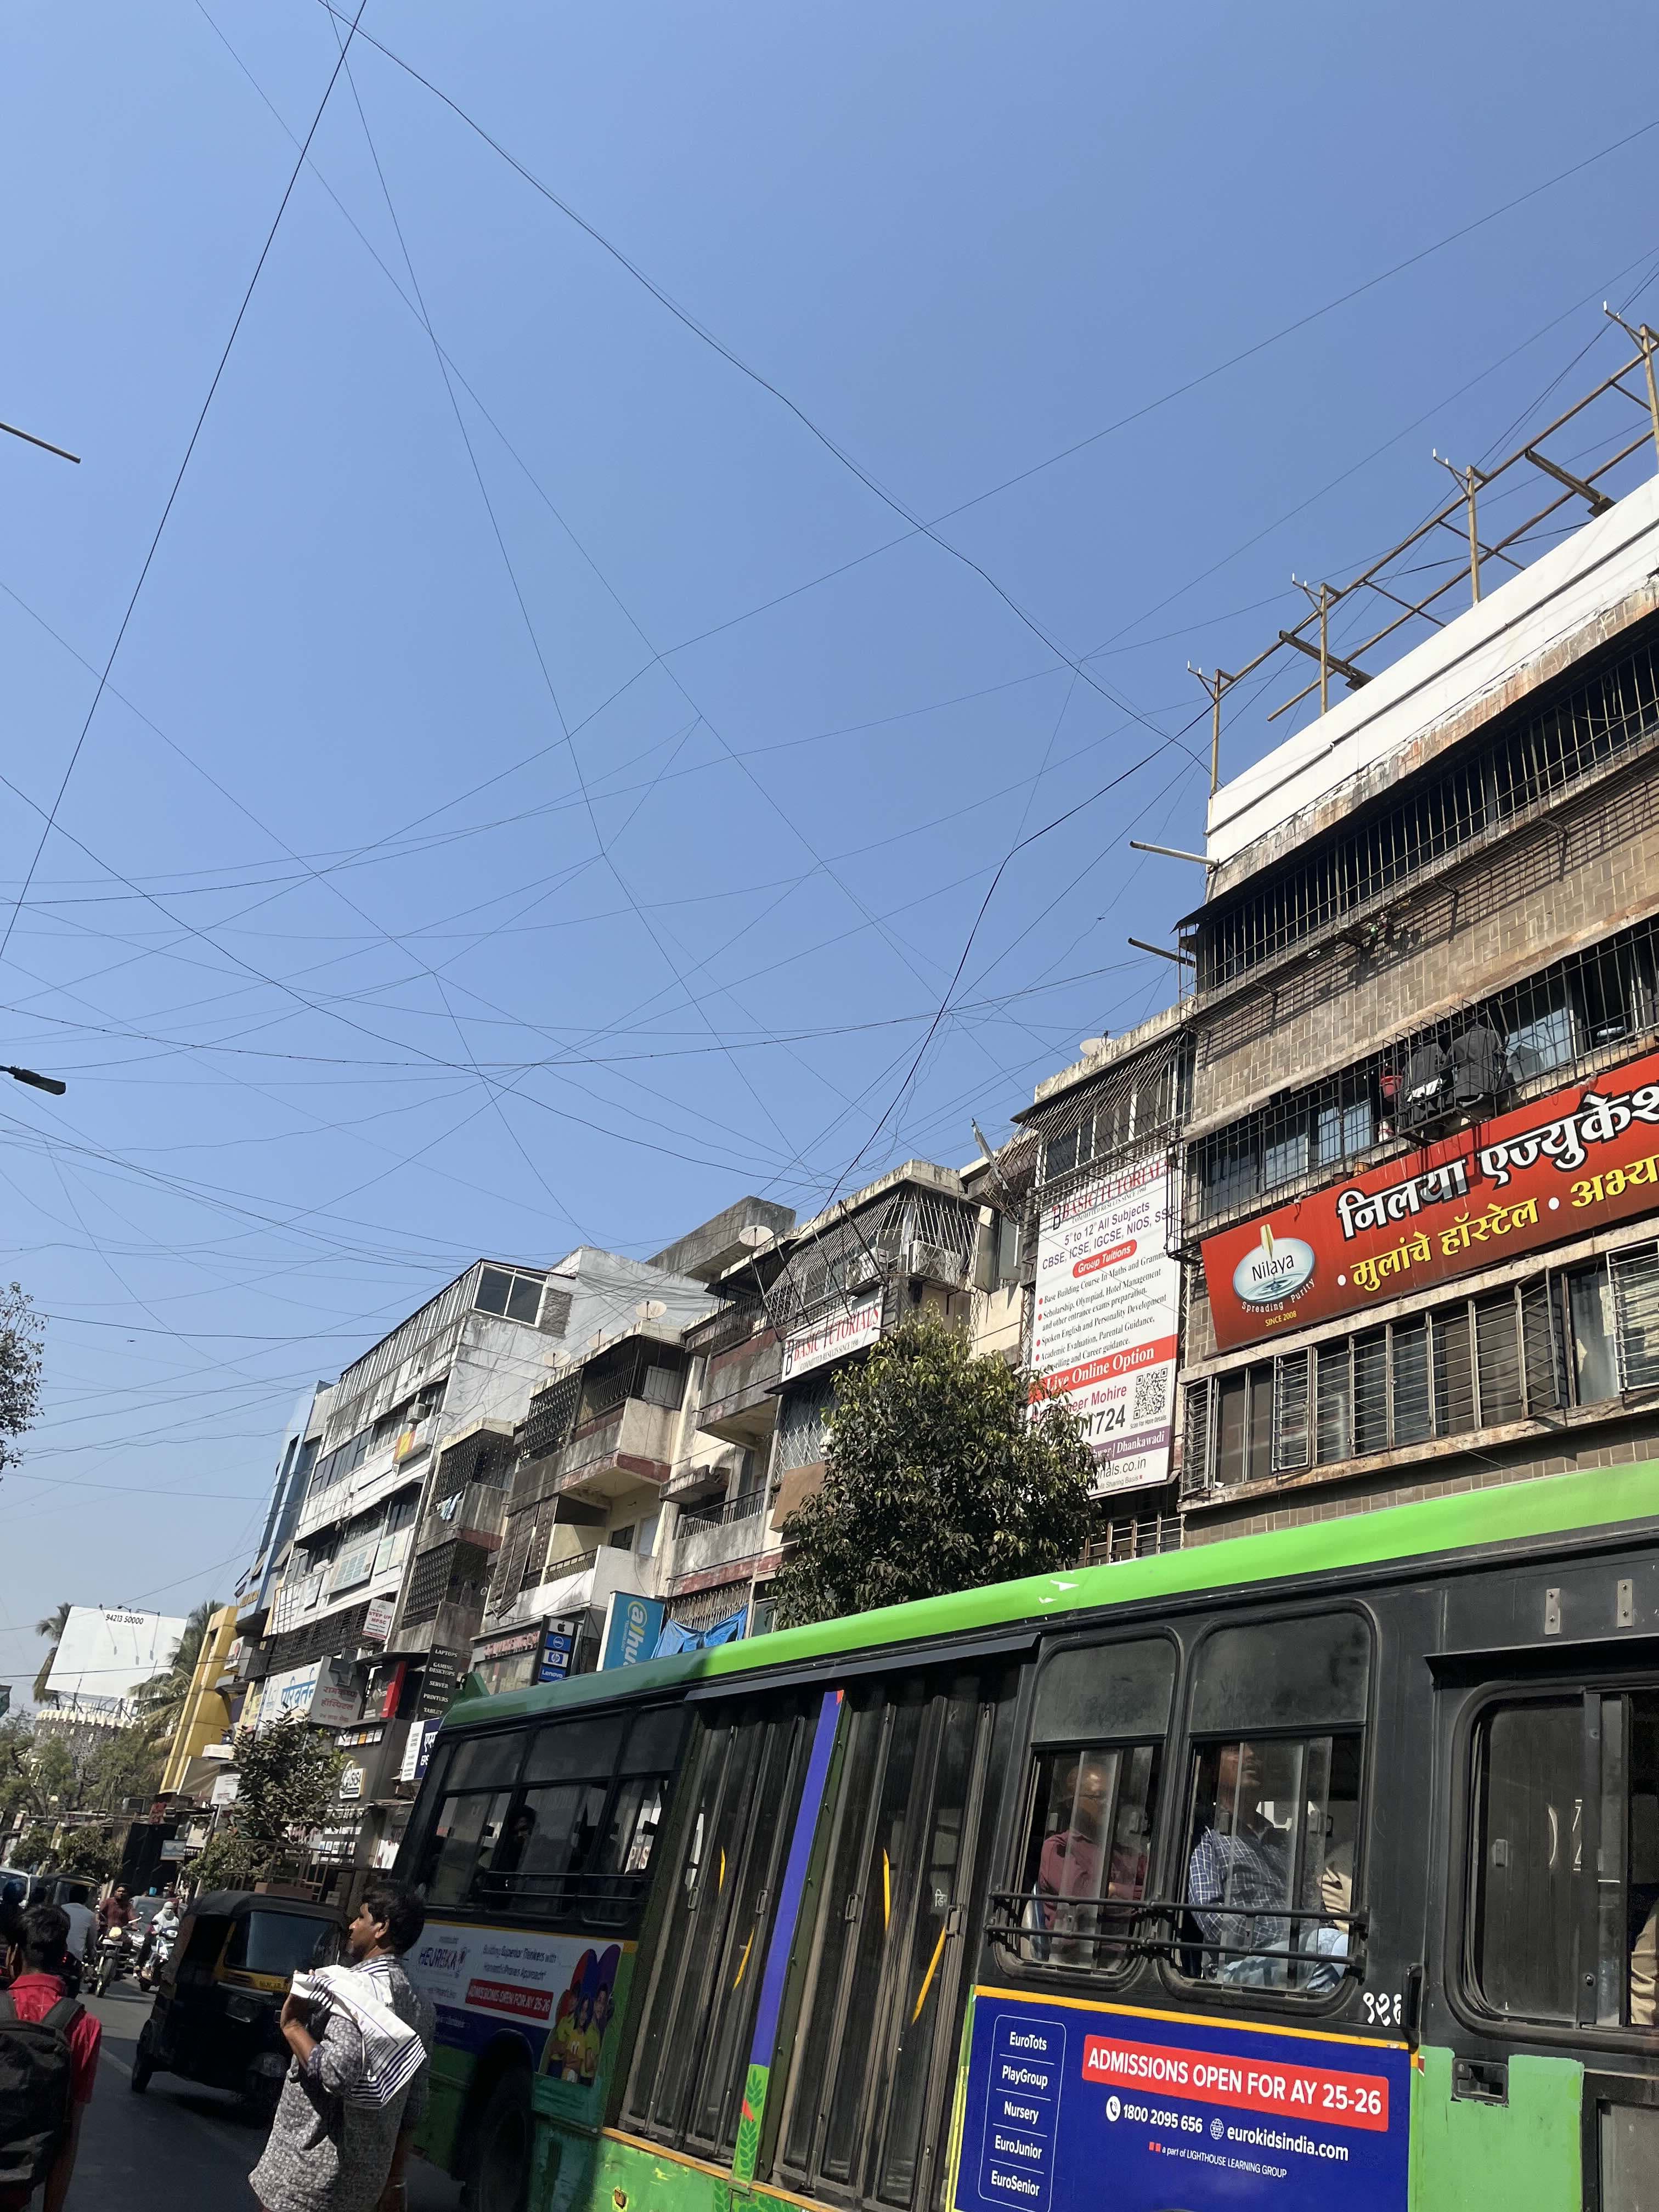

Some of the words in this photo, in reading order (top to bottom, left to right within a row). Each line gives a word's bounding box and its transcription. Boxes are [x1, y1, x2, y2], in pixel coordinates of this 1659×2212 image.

[1337, 1159, 1469, 1239] निलया
[1074, 1231, 1081, 1242] to
[1098, 1218, 1110, 1231] All
[1111, 1201, 1150, 1227] Subjects
[1042, 1251, 1067, 1270] CBSE,
[1070, 1241, 1092, 1260] ICSE,
[1094, 1228, 1124, 1249] IGCSE,
[1127, 1219, 1152, 1235] NIOS,
[1350, 1234, 1431, 1292] मुलांचे
[1441, 1198, 1538, 1256] हॉस्टेल
[1077, 1256, 1100, 1273] Group
[1102, 1245, 1131, 1263] Tuitions
[1252, 1255, 1294, 1281] Nilaya
[1045, 1294, 1056, 1304] Base
[1057, 1284, 1080, 1299] Building
[1081, 1278, 1099, 1290] Course
[1101, 1273, 1108, 1282] In
[1109, 1265, 1127, 1279] Maths
[1128, 1260, 1139, 1271] and
[1106, 1282, 1121, 1296] Hotel
[1122, 1268, 1161, 1290] Management
[1242, 1301, 1284, 1312] Spreading
[1290, 1278, 1315, 1303] Purity
[1042, 1321, 1052, 1331] and
[1053, 1315, 1067, 1328] other
[1068, 1307, 1091, 1322] entrance
[1092, 1301, 1110, 1313] exams
[1111, 1287, 1148, 1308] preparation.
[1042, 1330, 1060, 1346] Spoken
[1062, 1322, 1082, 1339] English
[1082, 1319, 1093, 1331] and
[1094, 1306, 1126, 1327] Personality
[1127, 1294, 1167, 1314] Development
[1265, 1314, 1282, 1327] SINCE
[1283, 1310, 1297, 1322] 2008
[794, 1330, 820, 1362] BASIC
[1041, 1346, 1065, 1361] Academic
[1099, 1326, 1124, 1342] Parental
[1070, 1352, 1081, 1364] and
[1082, 1348, 1102, 1361] Career
[1046, 1375, 1069, 1391] Live
[1071, 1361, 1109, 1384] Online
[1113, 1347, 1154, 1372] Option
[1091, 1386, 1127, 1406] Mohire
[1117, 1430, 1165, 1453] Dhankawadi
[106, 1614, 123, 1623] 94213
[123, 1616, 144, 1624] 50000
[433, 1662, 454, 1671] GAMING
[435, 1649, 458, 1657] LAPTOPS
[429, 1667, 455, 1677] DESKTOPS
[429, 1680, 449, 1689] SERVER
[542, 1669, 563, 1679] Lenovo
[423, 1693, 449, 1702] PRINTERS
[424, 1707, 443, 1716] TABLET
[1009, 2031, 1047, 2051] EuroTots
[1002, 2064, 1048, 2090] PlayGroup
[1087, 2047, 1189, 2085] ADMISSIONS
[1193, 2062, 1243, 2093] OPEN
[1247, 2070, 1286, 2100] FOR
[1290, 2077, 1317, 2104] AY
[1322, 2083, 1383, 2115] 25-26
[1004, 2101, 1039, 2125] Nursery
[1123, 2103, 1149, 2122] 1800
[1150, 2109, 1178, 2128] 2095
[1181, 2115, 1203, 2133] 656
[995, 2135, 1042, 2159] EuroJunior
[1227, 2126, 1349, 2162] eurokidsindia.com
[1166, 2147, 1179, 2157] part
[1180, 2149, 1186, 2157] of
[1187, 2150, 1226, 2166] LIGHTHOUSE
[1228, 2158, 1260, 2173] LEARNING
[1262, 2165, 1287, 2177] GROUP
[991, 2170, 1040, 2197] EuroSenior
